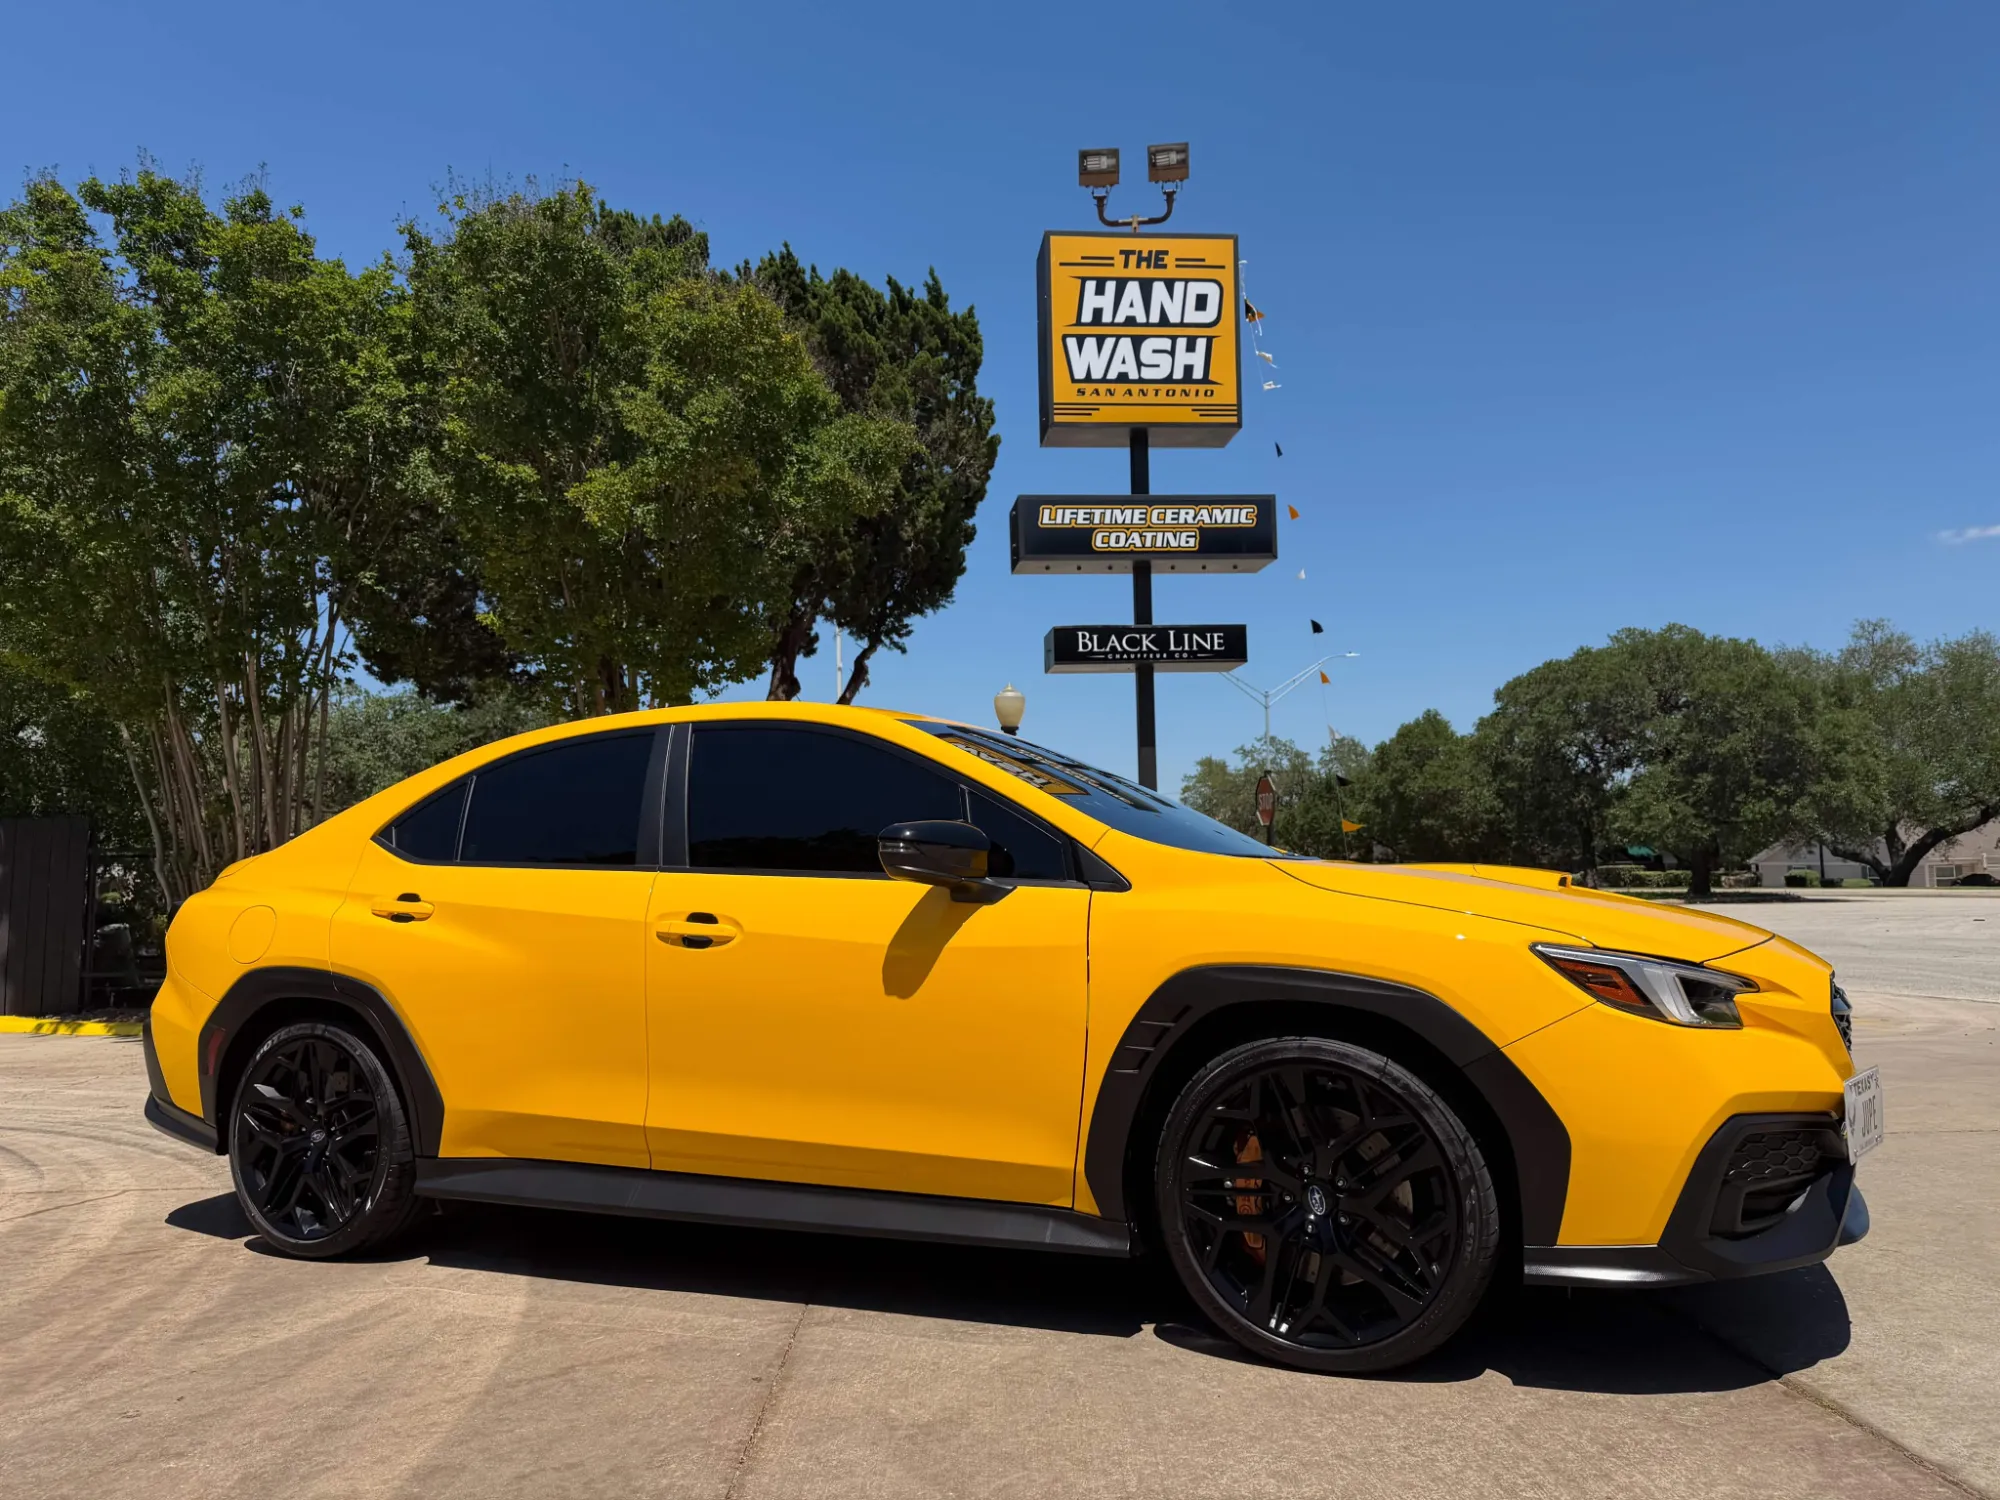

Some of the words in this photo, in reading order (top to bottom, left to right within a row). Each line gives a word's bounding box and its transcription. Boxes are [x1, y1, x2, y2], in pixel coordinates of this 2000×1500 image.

[1119, 249, 1169, 269] THE
[1080, 279, 1221, 324] HAND
[1065, 336, 1208, 380] WASH
[1076, 387, 1116, 397] SAN
[1122, 388, 1215, 398] ANTONIO
[1040, 506, 1149, 526] LIFETIME
[1150, 506, 1256, 526] CERAMIC
[1093, 529, 1198, 549] COATING
[1077, 631, 1160, 652] BLACK
[1168, 630, 1225, 651] LINE
[1107, 652, 1168, 660] CHAUFFEUR
[1258, 792, 1273, 810] STOP
[1854, 1077, 1871, 1096] TEXAS
